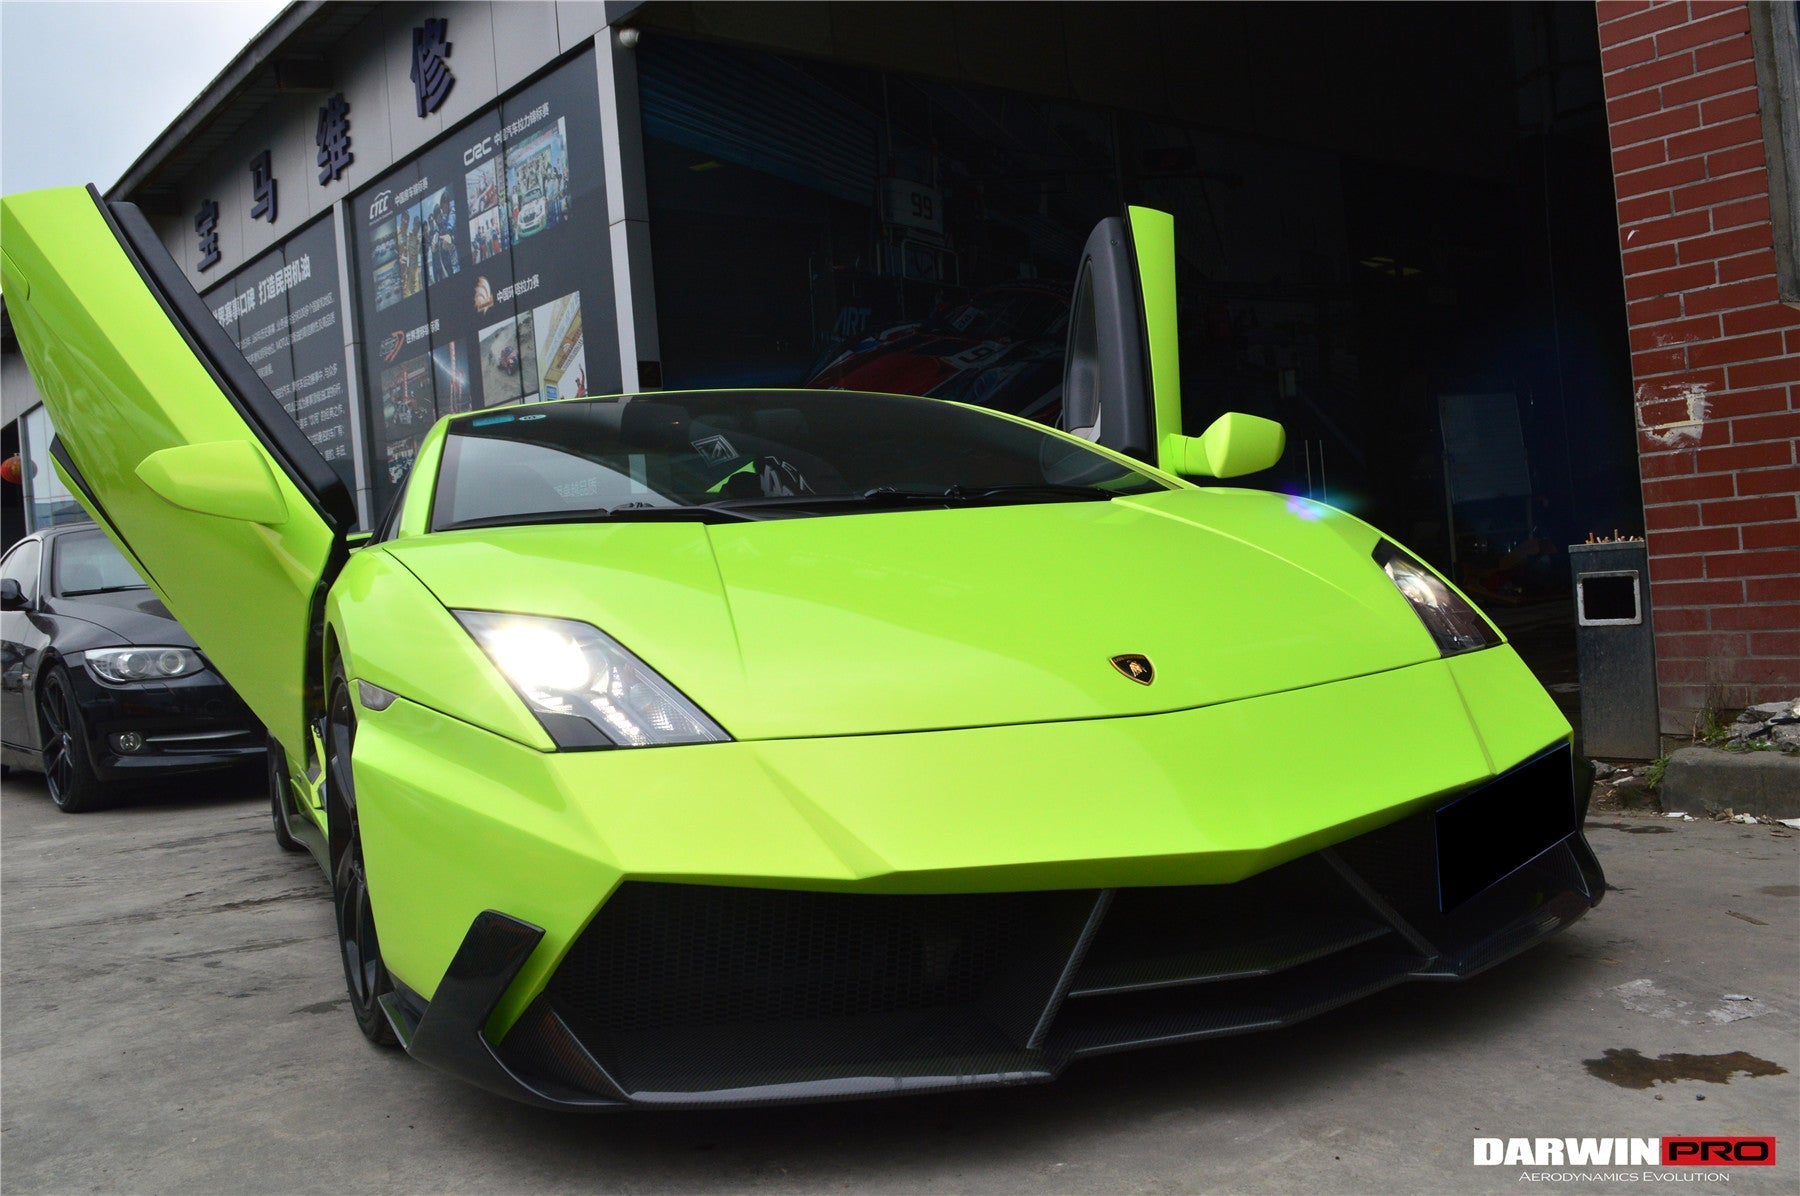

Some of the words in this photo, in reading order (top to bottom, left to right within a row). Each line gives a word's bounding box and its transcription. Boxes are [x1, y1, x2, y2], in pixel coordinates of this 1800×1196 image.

[194, 18, 456, 273] 宝马维修
[369, 194, 390, 220] CTCC
[258, 253, 311, 306] 打造民用机油
